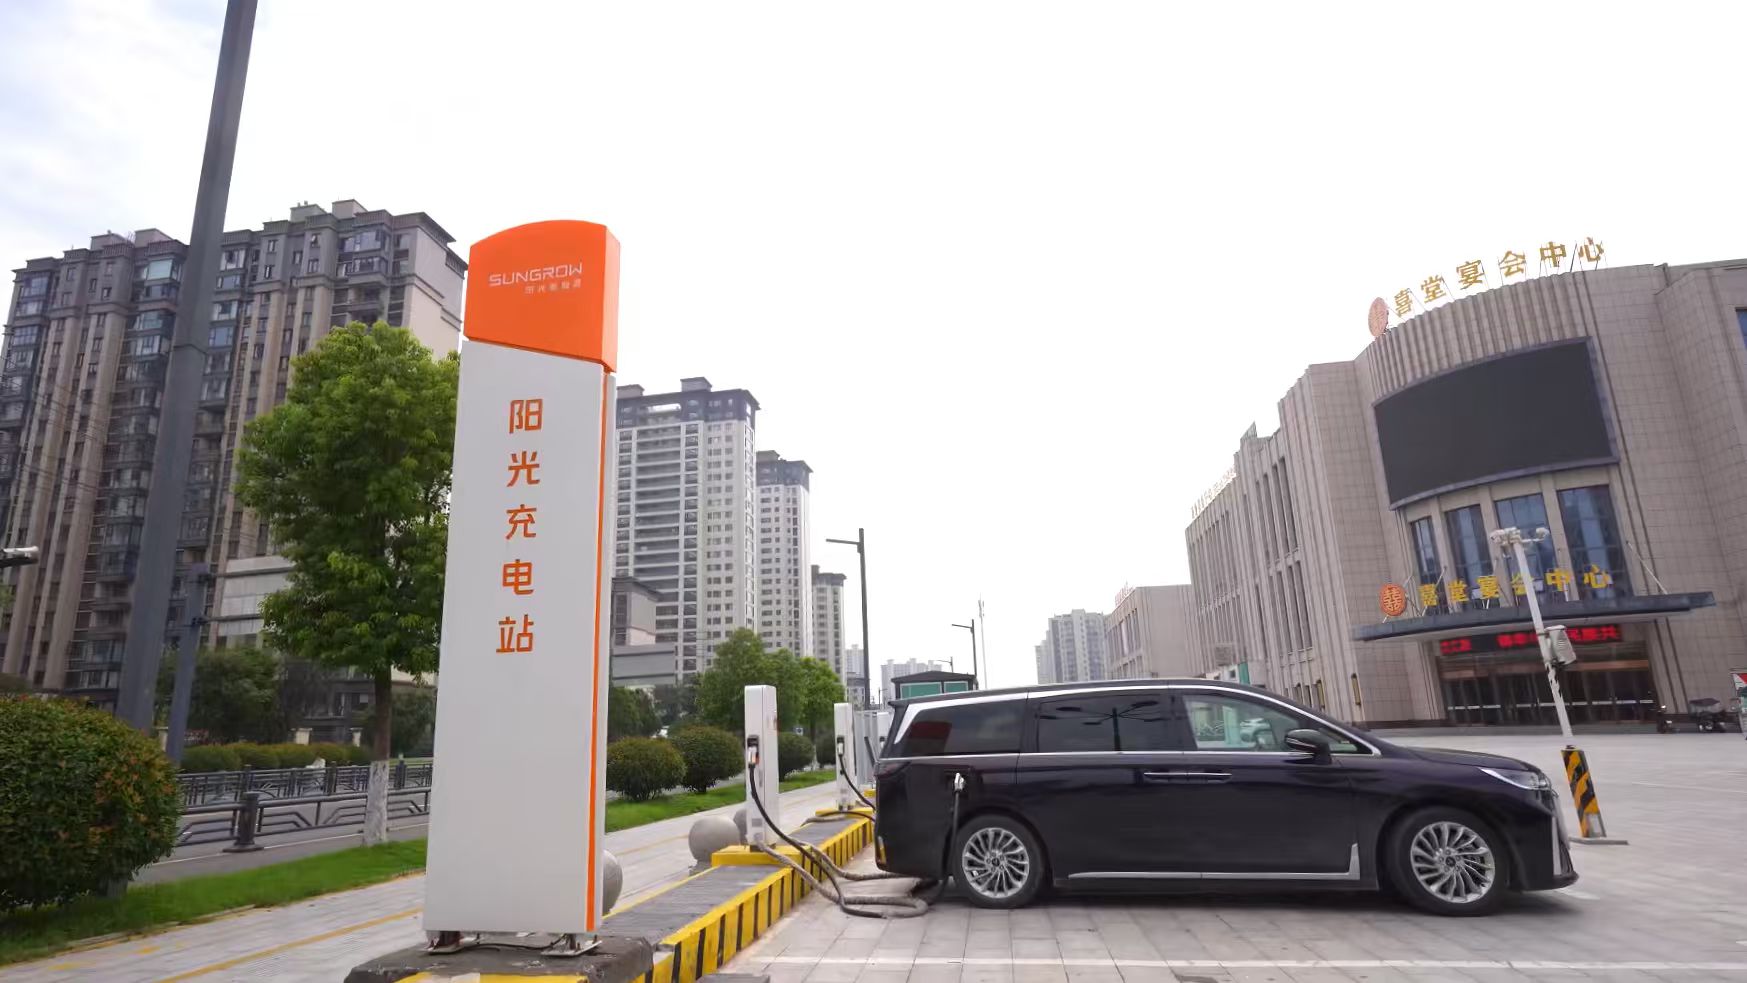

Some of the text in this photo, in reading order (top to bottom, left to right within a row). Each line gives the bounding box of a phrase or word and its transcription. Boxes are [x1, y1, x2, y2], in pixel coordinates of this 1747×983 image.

[489, 263, 583, 287] SUNGROW
[1393, 237, 1605, 317] 喜堂宴会中心
[495, 398, 544, 655] 阳光充电站
